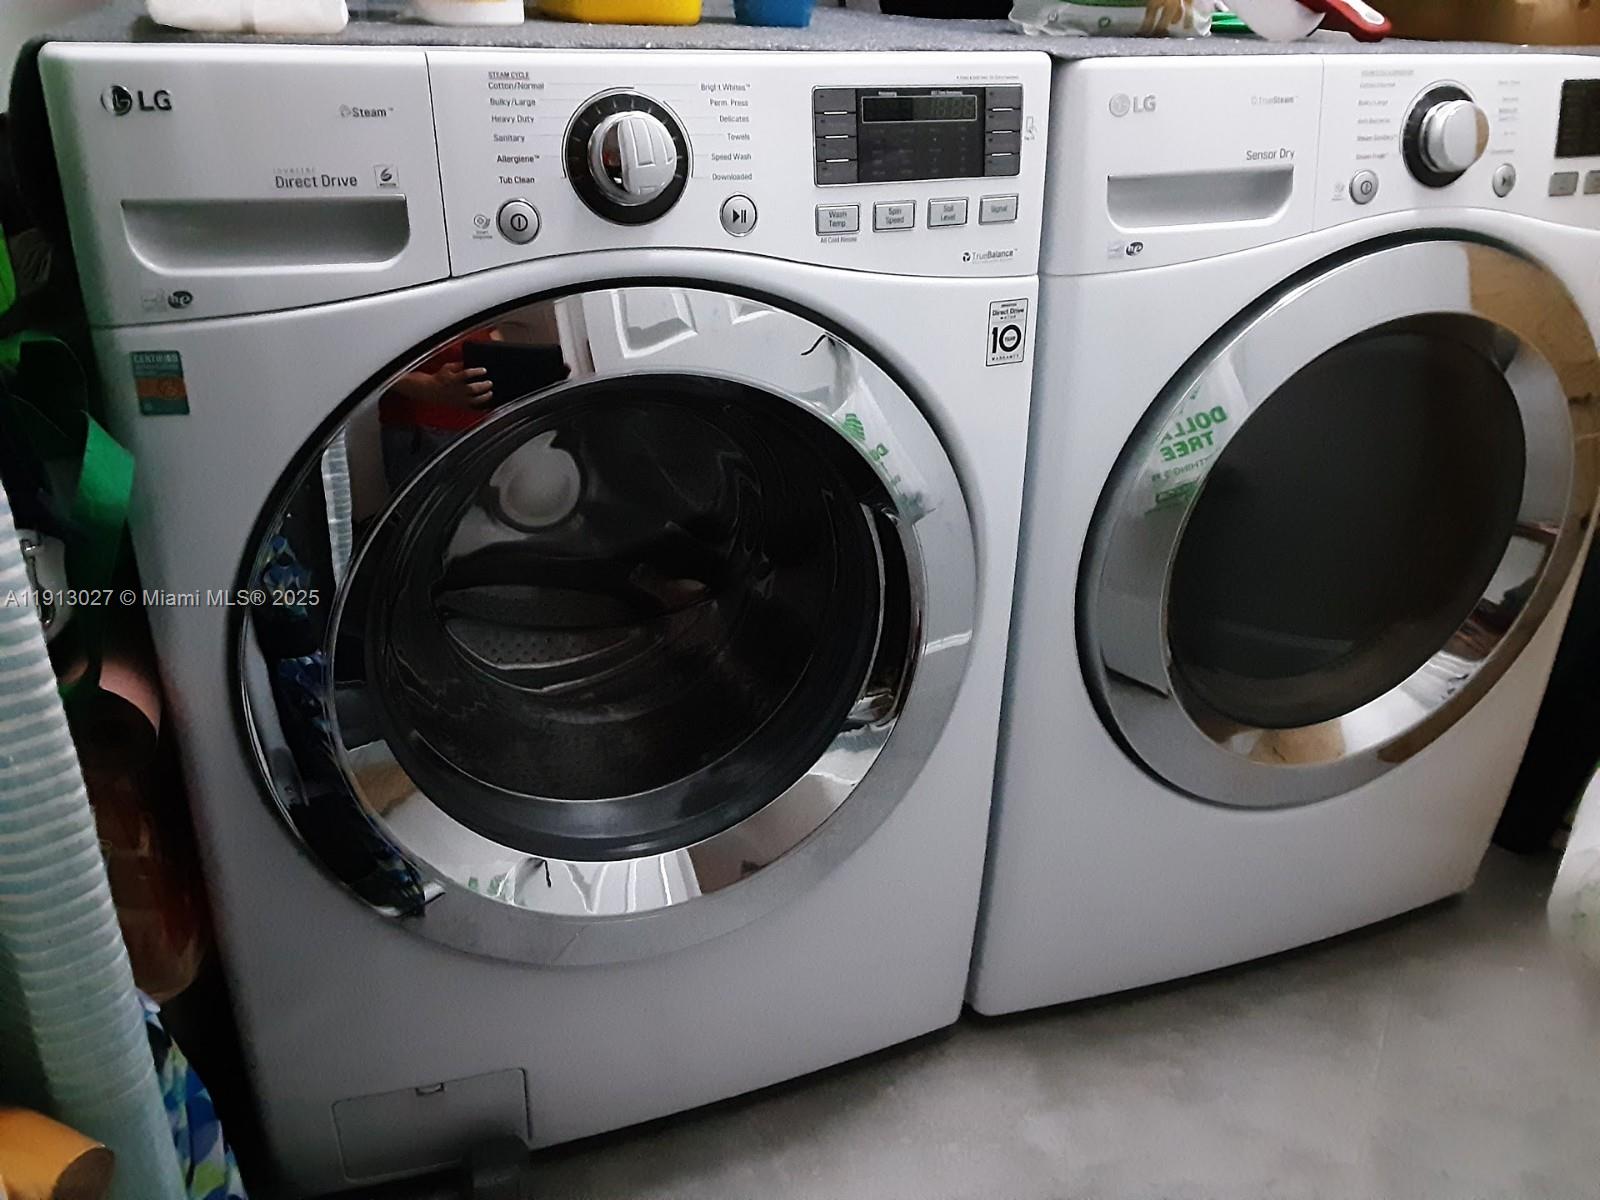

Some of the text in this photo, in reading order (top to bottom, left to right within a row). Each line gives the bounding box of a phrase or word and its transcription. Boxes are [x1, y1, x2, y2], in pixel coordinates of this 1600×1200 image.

[488, 82, 544, 90] Cotton/Normal
[138, 90, 172, 111] LG
[490, 98, 536, 107] Bulky/Large
[1133, 95, 1156, 112] LG
[492, 115, 535, 123] Heavy Duty
[493, 134, 525, 143] Sanitary
[728, 133, 750, 141] Towels
[711, 153, 751, 162] Speed Wash
[1246, 148, 1295, 161] Sensor Dry
[275, 174, 358, 188] Direct Drive
[499, 175, 535, 184] Tub Clean
[712, 173, 752, 181] Downloaded
[829, 219, 846, 228] Temp
[992, 324, 1022, 353] 10
